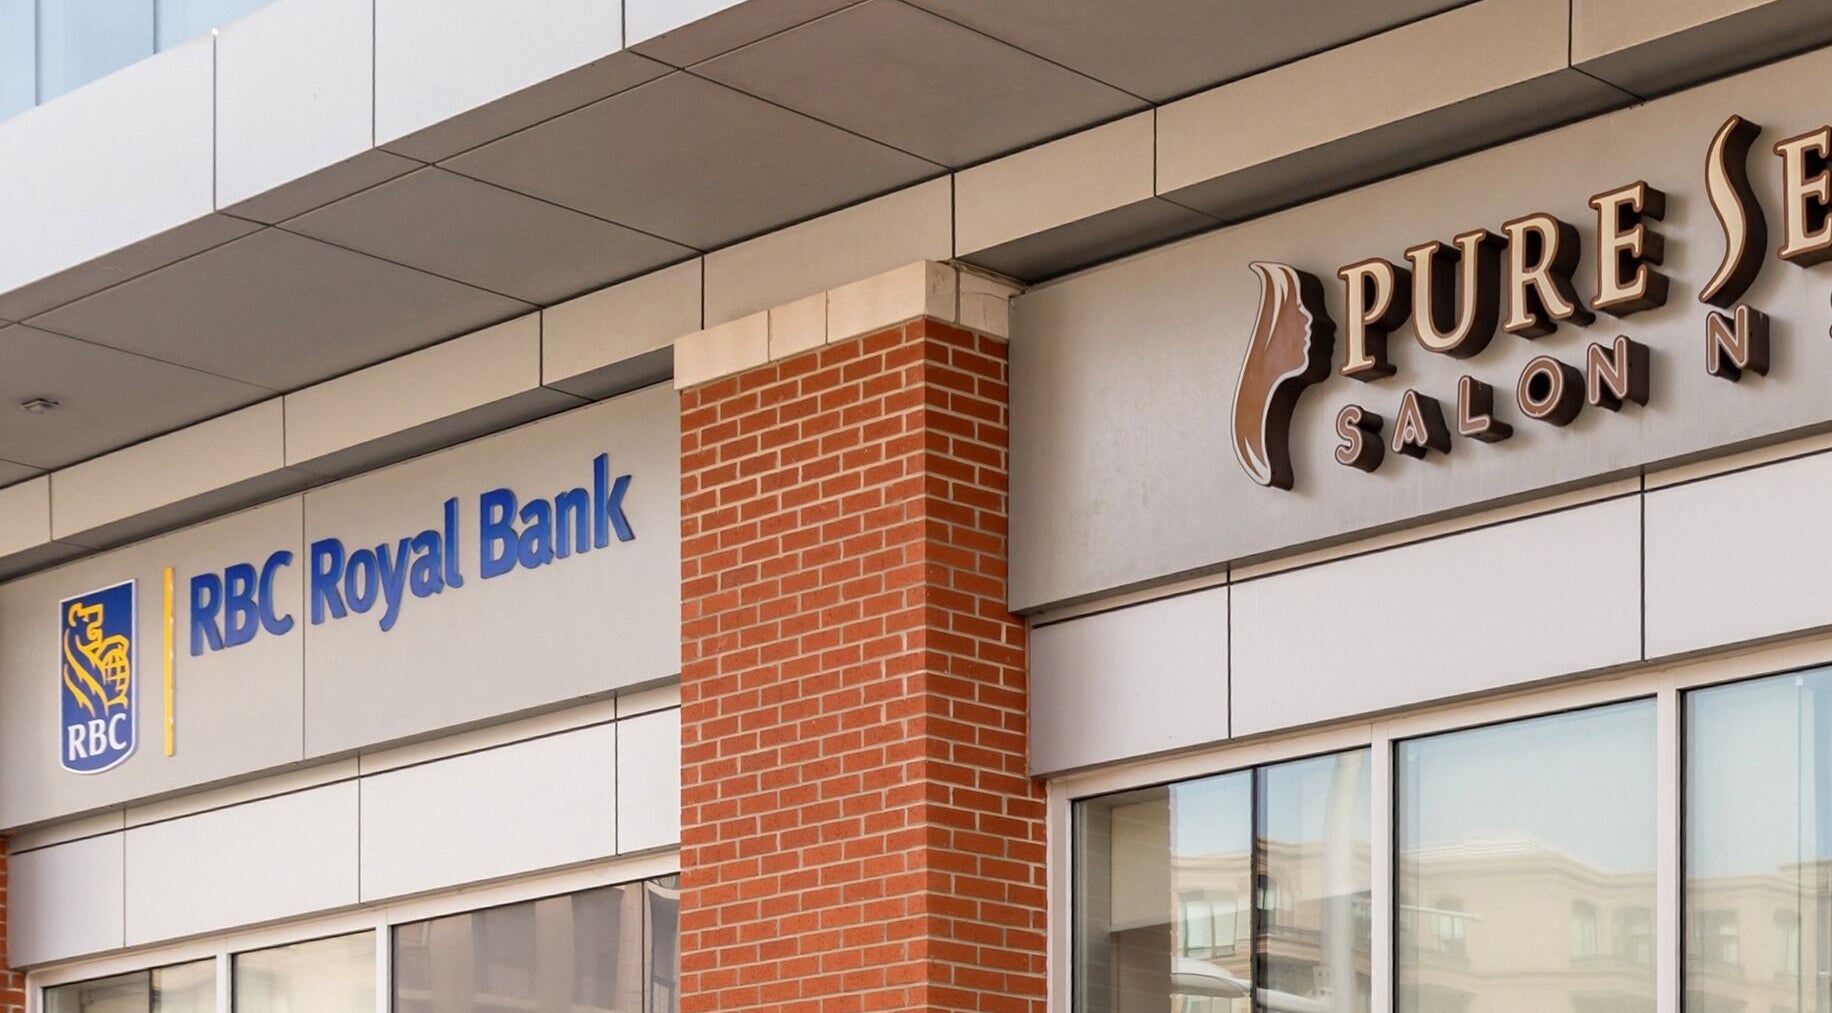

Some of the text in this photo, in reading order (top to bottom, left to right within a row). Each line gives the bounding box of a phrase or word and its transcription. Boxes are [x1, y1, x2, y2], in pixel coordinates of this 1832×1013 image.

[1338, 180, 1669, 382] PURE
[1334, 335, 1650, 472] SALON
[1705, 304, 1770, 382] N
[190, 453, 635, 657] RBC Royal Bank
[67, 713, 127, 761] RBC
